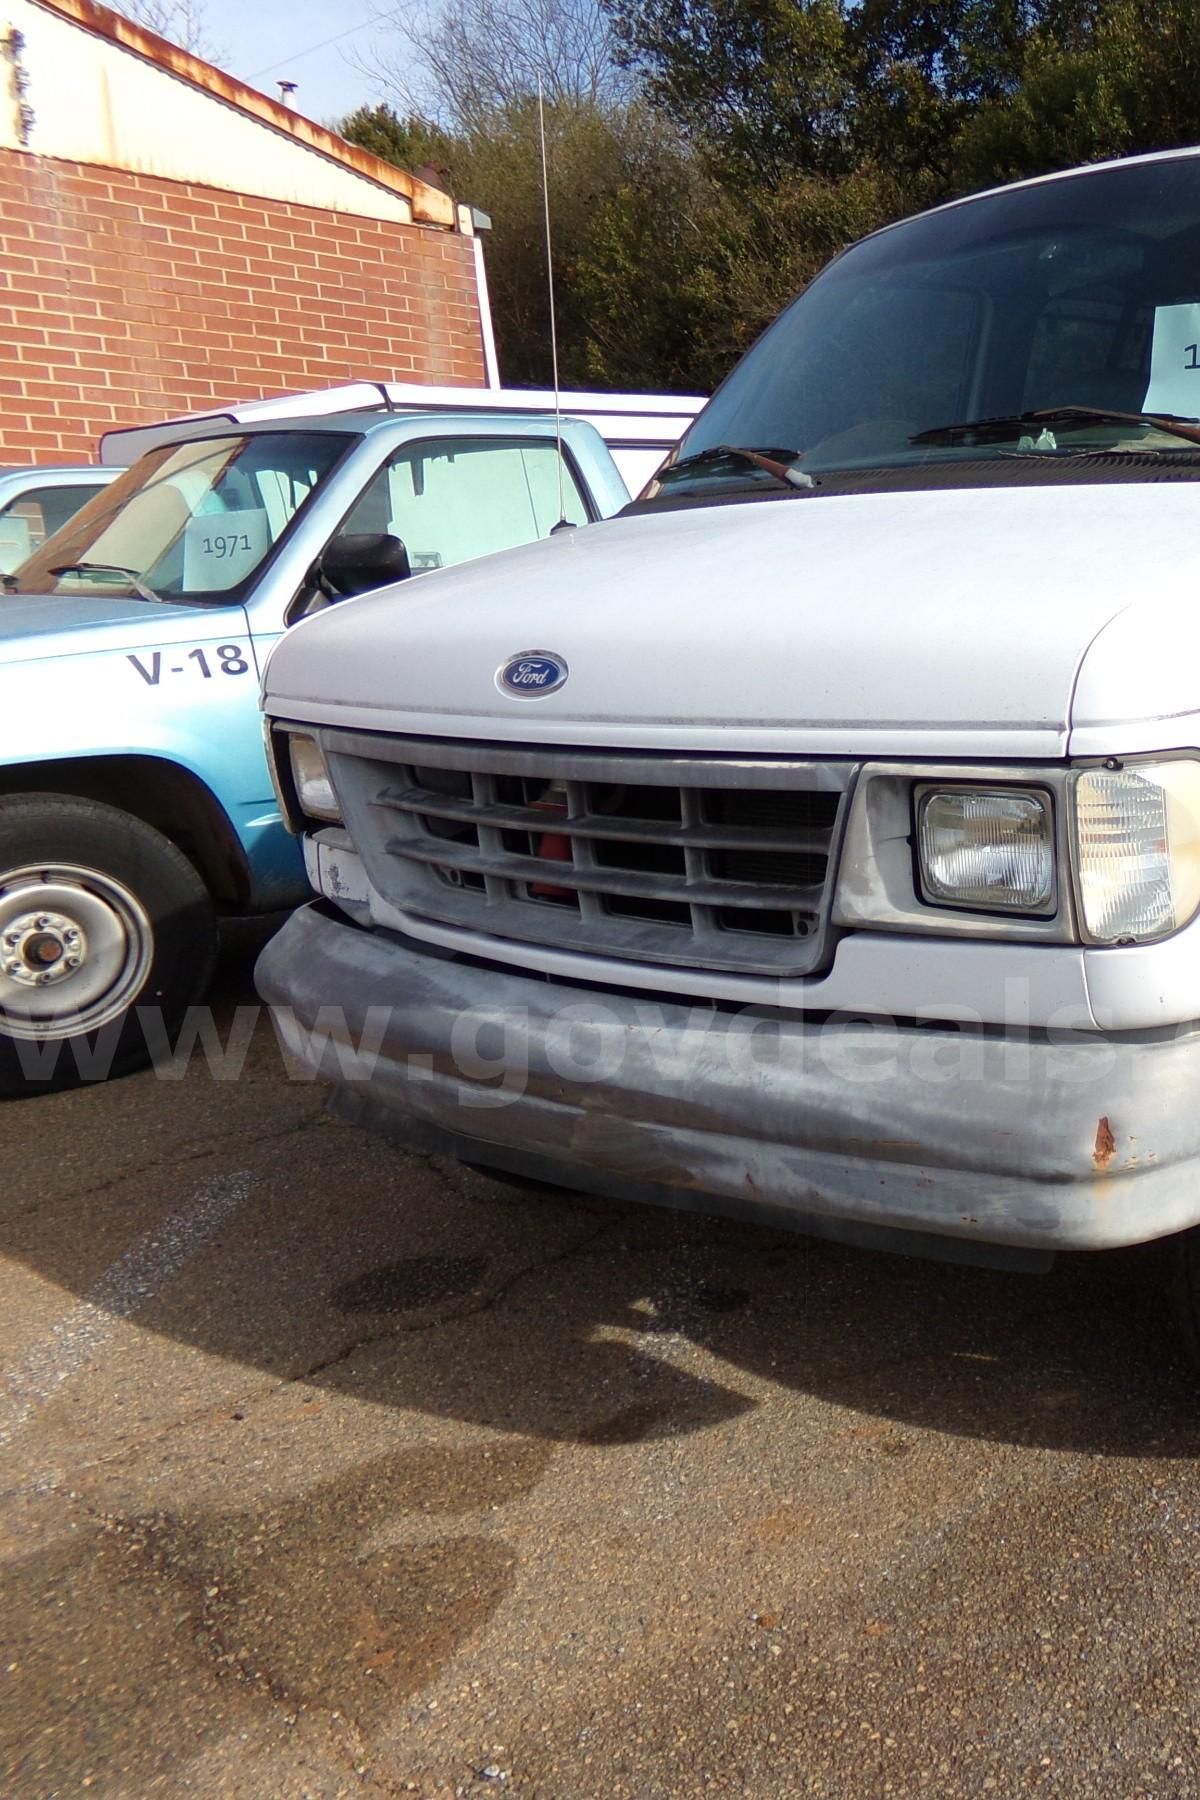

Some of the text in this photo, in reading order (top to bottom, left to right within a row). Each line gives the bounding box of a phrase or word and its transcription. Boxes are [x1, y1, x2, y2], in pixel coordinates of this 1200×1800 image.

[202, 534, 252, 559] 1971
[125, 644, 249, 686] V-18
[512, 662, 550, 685] Ford
